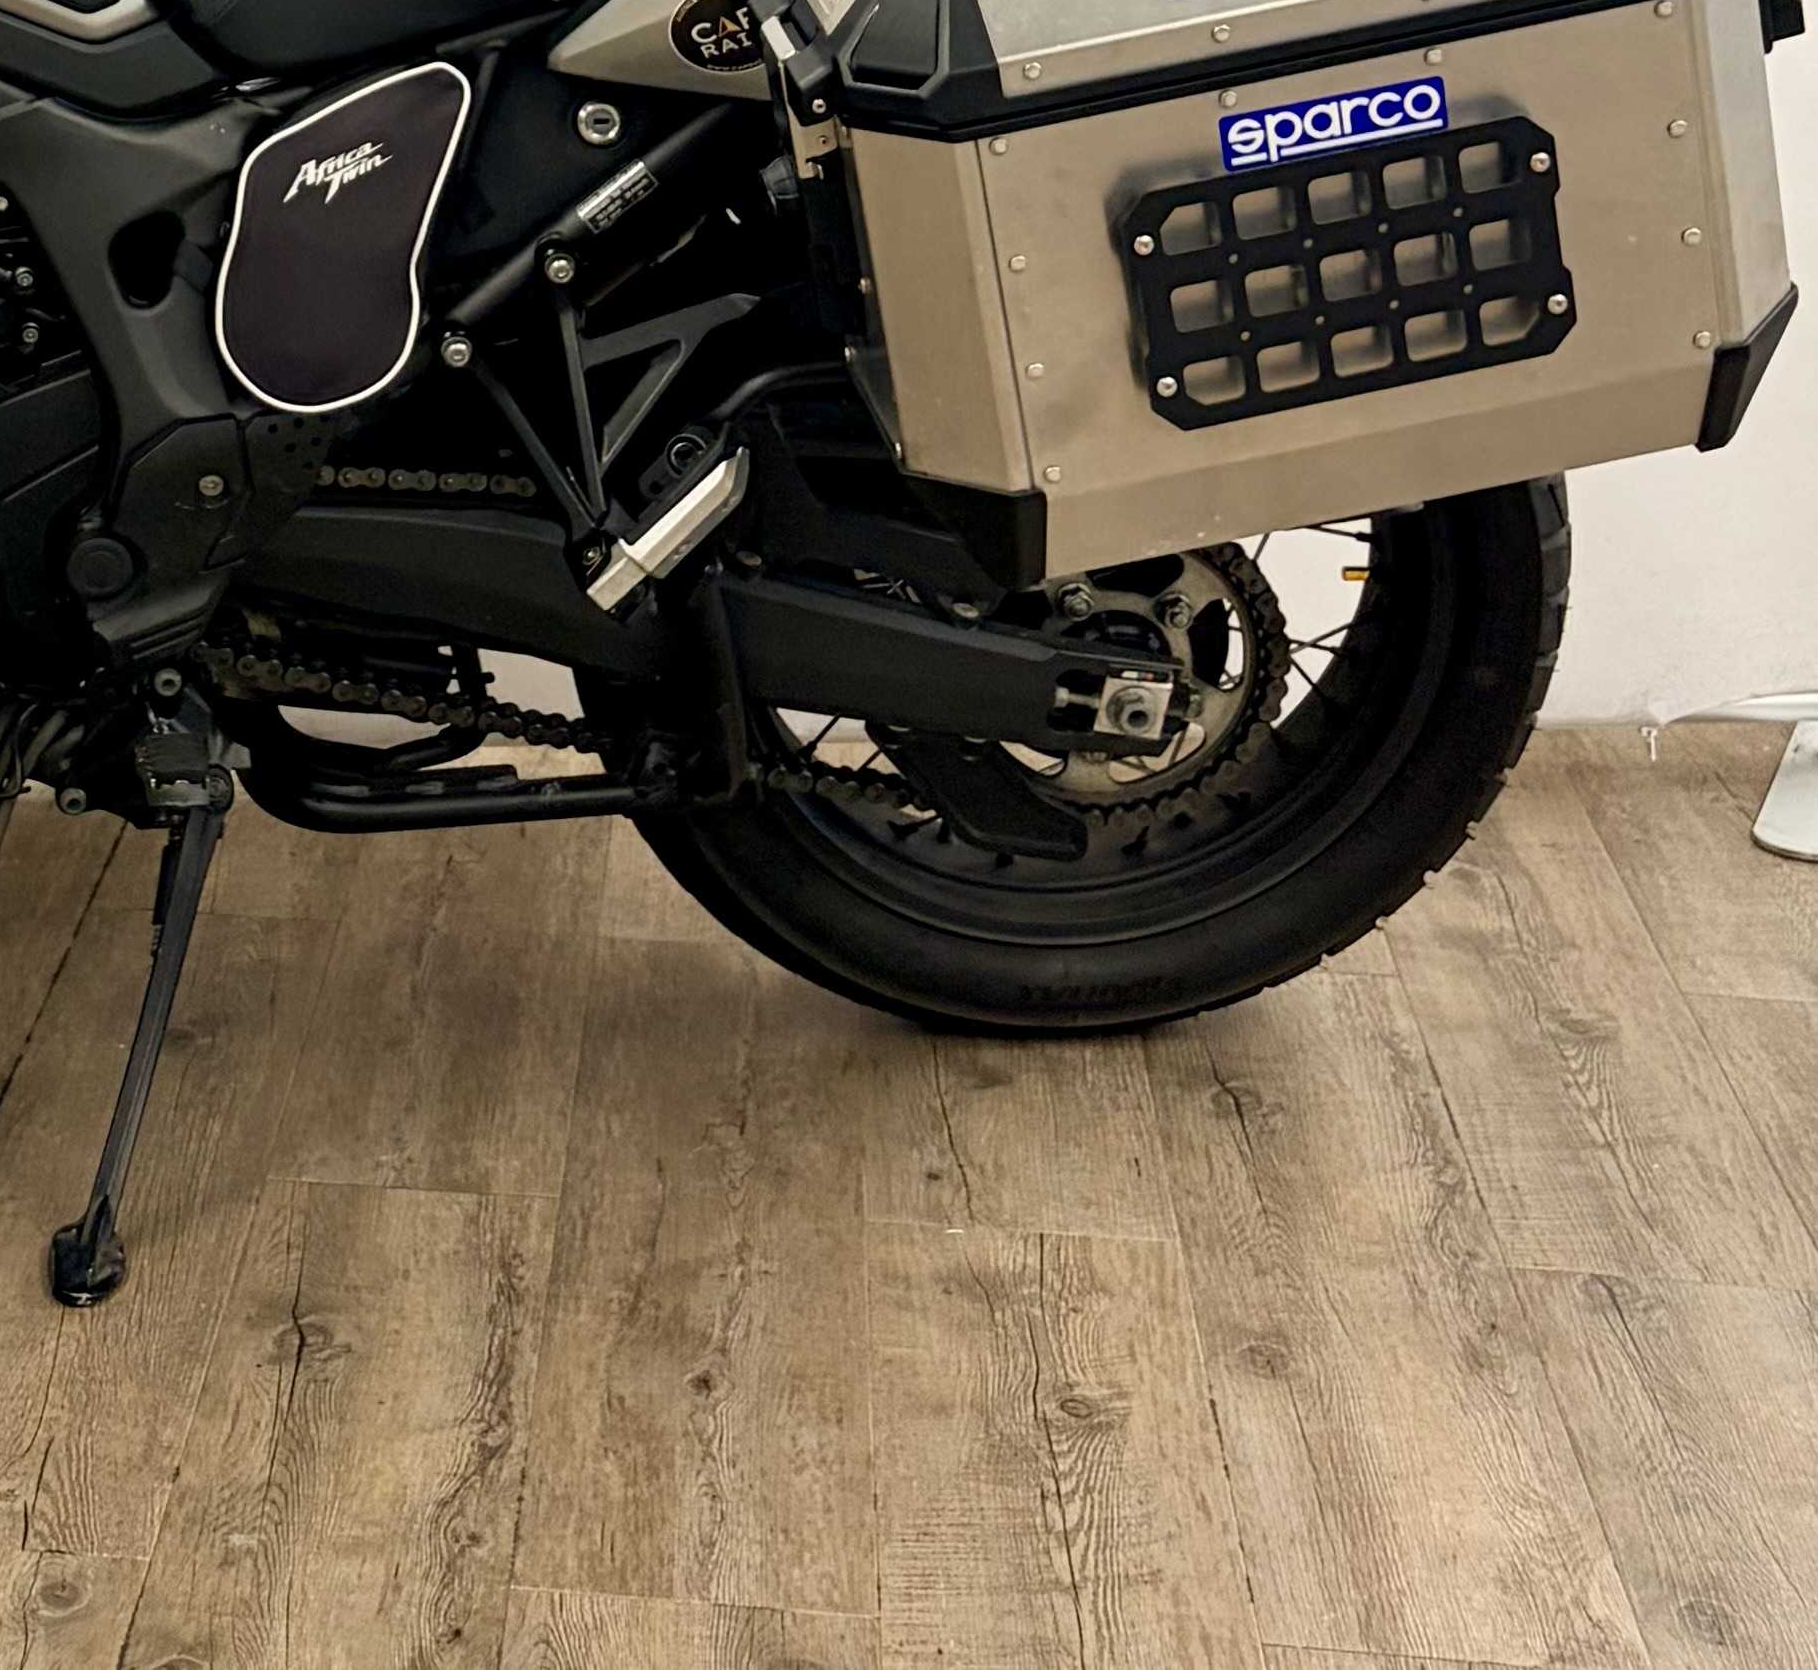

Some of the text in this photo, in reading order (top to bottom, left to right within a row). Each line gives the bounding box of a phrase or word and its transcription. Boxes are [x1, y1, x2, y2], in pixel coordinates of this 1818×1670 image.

[700, 32, 753, 59] RAI
[1227, 84, 1443, 166] sparco
[283, 141, 384, 203] Africa
[323, 153, 394, 204] Twin
